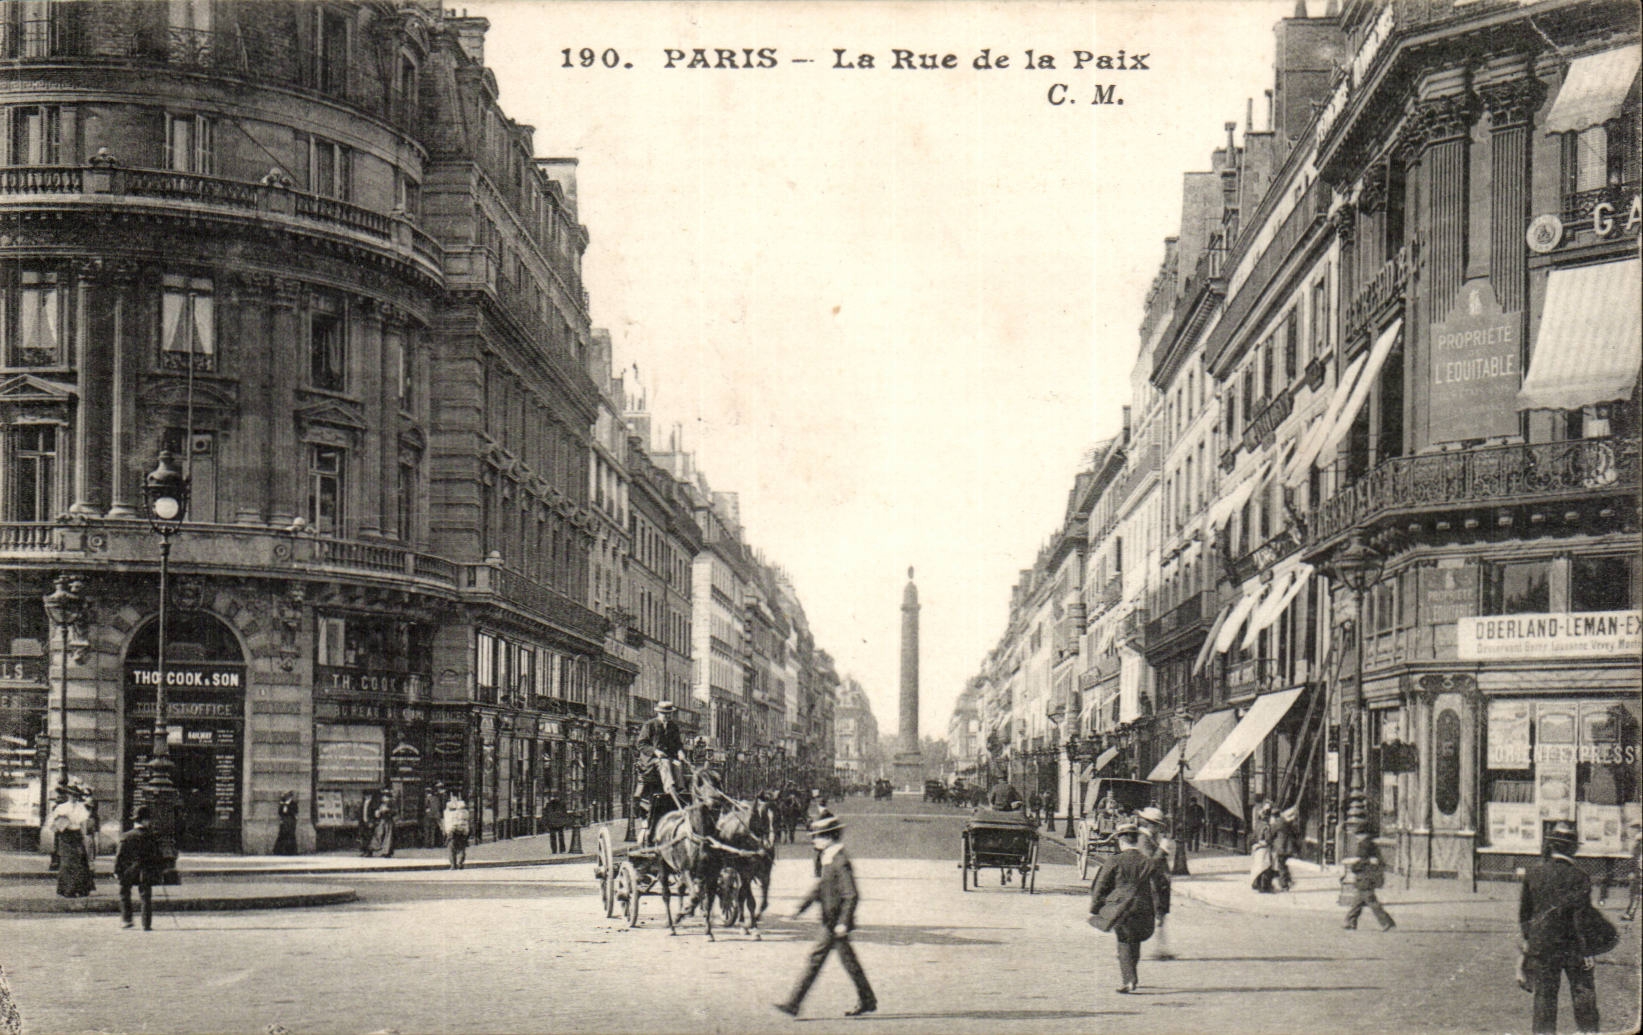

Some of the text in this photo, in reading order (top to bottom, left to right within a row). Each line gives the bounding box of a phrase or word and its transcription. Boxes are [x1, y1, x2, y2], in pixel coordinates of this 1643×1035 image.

[166, 671, 203, 686] COOK
[212, 672, 240, 687] SON
[360, 674, 397, 693] COOK
[1550, 744, 1635, 765] EXPRESS
